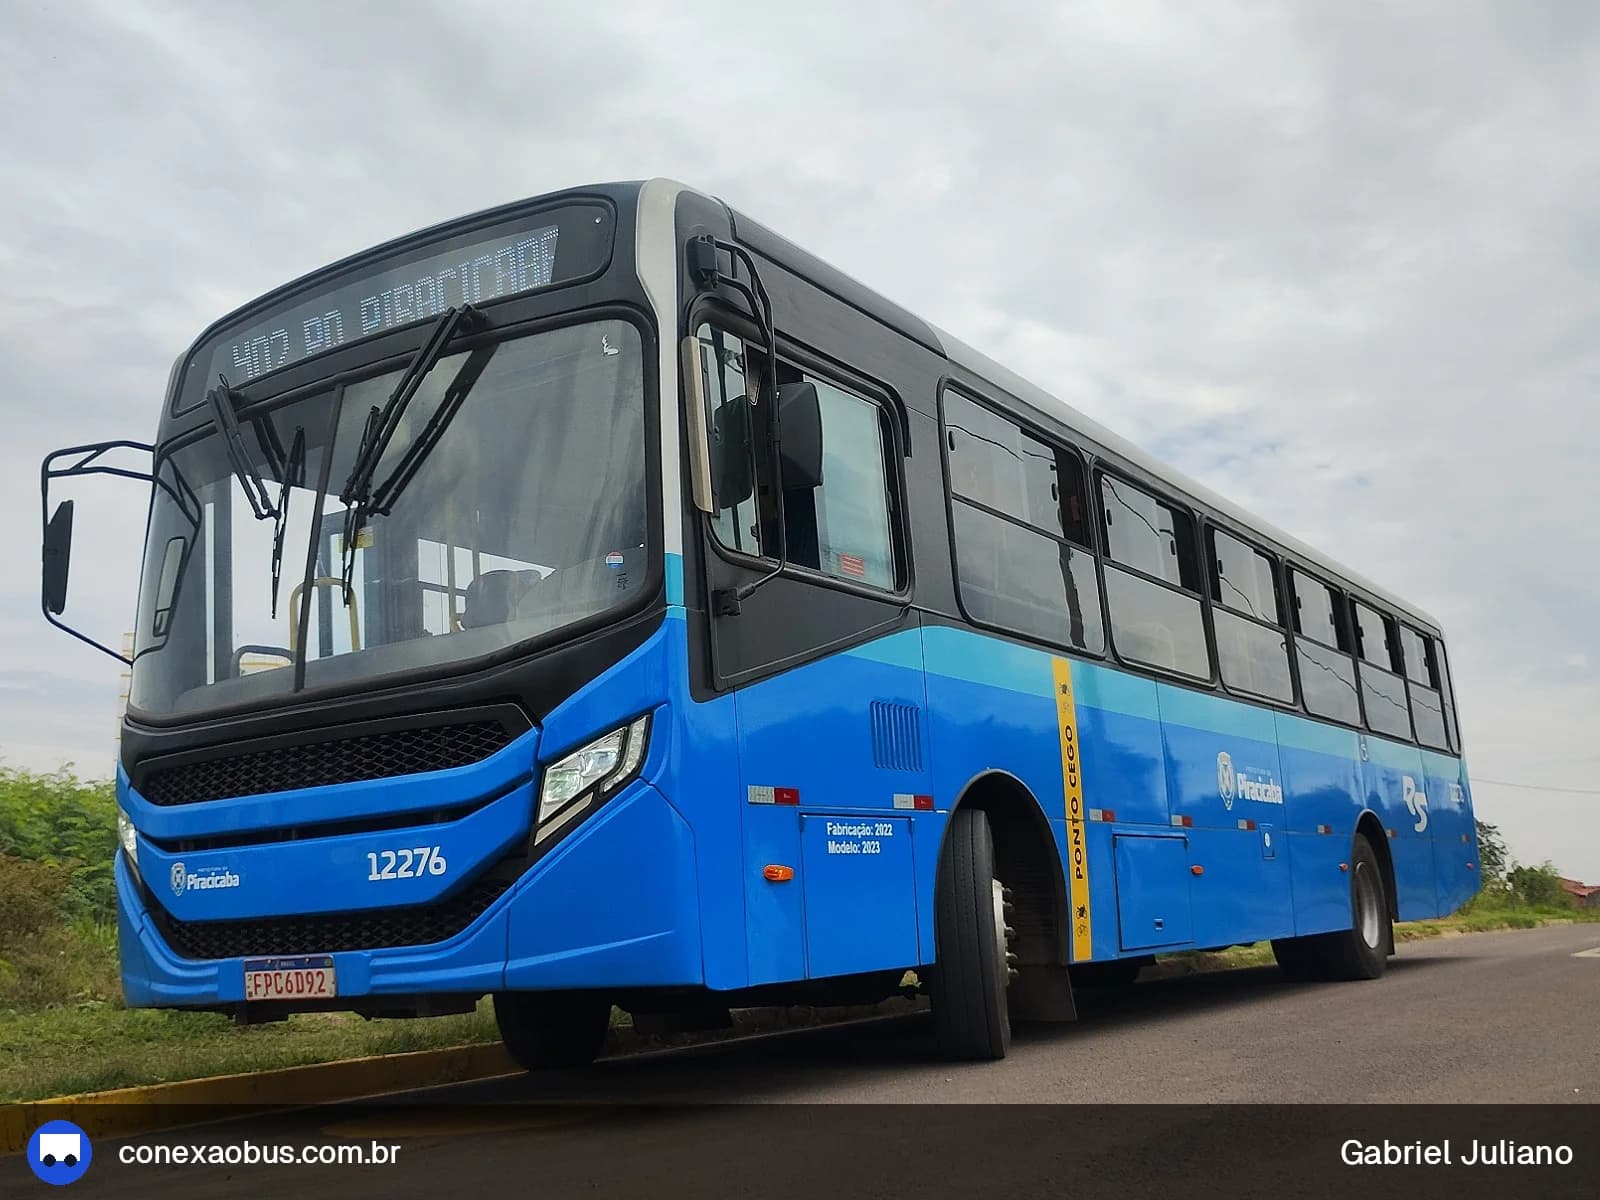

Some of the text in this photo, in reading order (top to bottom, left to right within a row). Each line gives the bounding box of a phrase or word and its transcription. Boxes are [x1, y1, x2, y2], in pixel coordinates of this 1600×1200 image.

[1065, 724, 1083, 880] PONTO CEGO
[826, 822, 893, 839] Fabricação: 2022
[828, 841, 881, 854] Modelo: 2023
[367, 845, 447, 881] 12276
[186, 871, 240, 890] Piracicaba
[253, 970, 326, 996] FPC6D92
